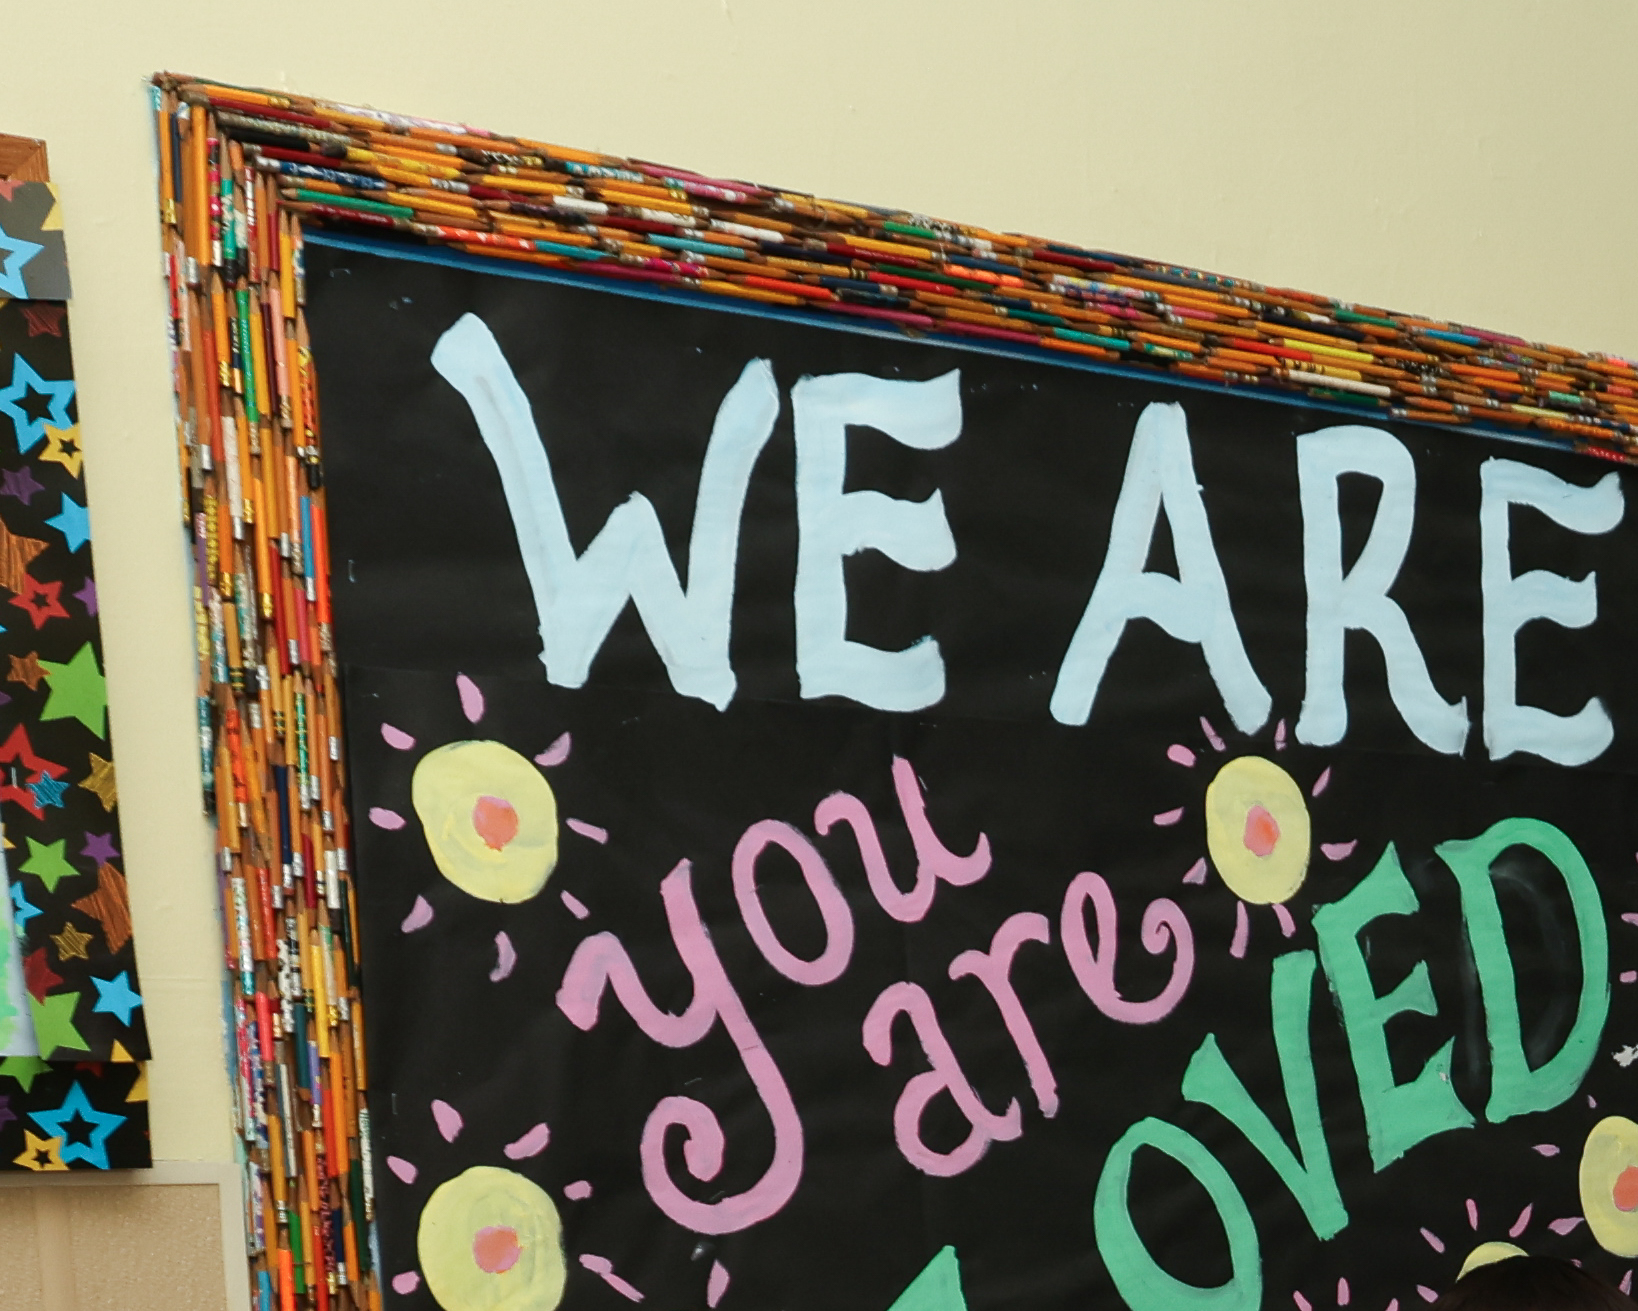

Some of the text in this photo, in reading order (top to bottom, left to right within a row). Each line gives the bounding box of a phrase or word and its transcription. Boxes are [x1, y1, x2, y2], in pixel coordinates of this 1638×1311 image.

[430, 312, 962, 711] WE
[1050, 401, 1625, 766] ARE
[556, 756, 991, 1235] you
[862, 871, 1195, 1176] are
